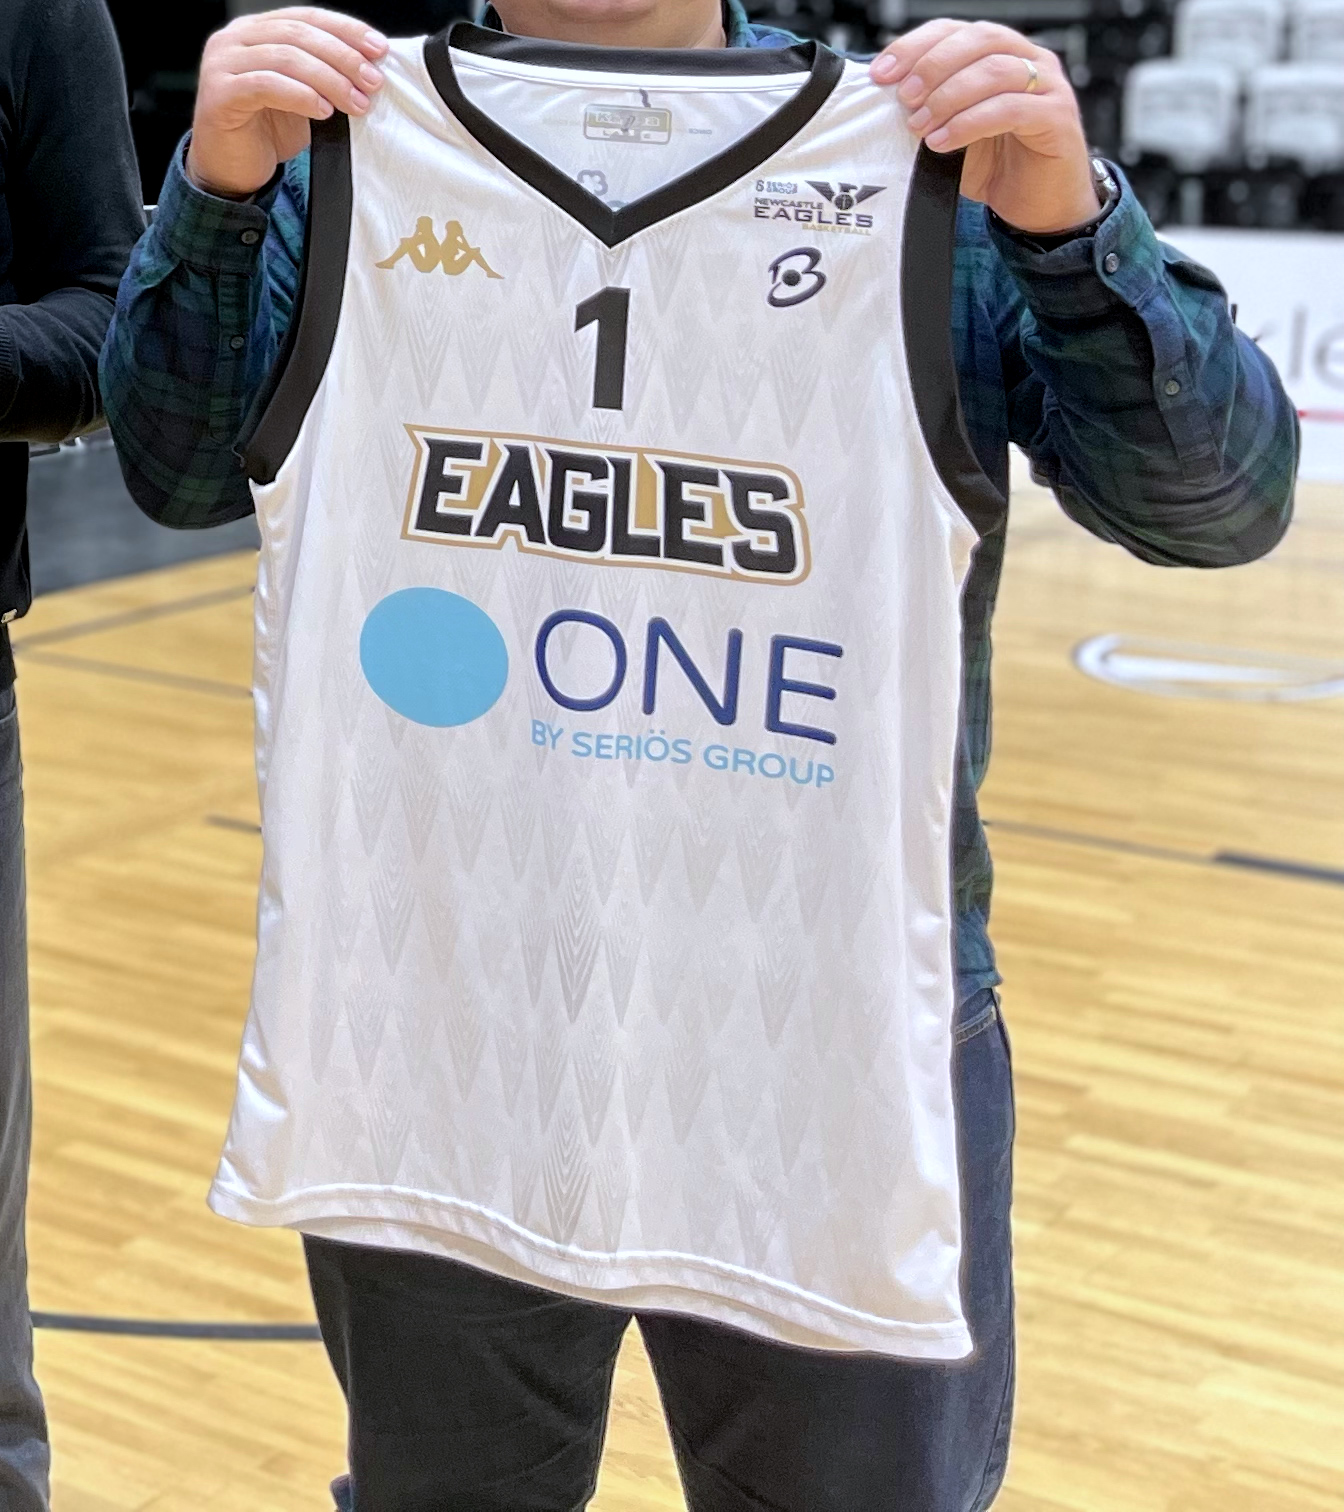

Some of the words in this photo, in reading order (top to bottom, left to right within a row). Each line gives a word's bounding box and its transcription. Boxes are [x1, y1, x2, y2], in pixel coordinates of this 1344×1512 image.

[753, 205, 874, 228] EAGLES
[754, 197, 824, 210] NEWCASTLE
[801, 222, 871, 236] BASKETBALL
[573, 286, 631, 411] 1
[410, 433, 804, 578] EAGLES
[534, 608, 844, 746] ONE
[531, 719, 564, 750] BY
[571, 729, 692, 765] SERIÖS
[703, 745, 835, 788] GROUP
